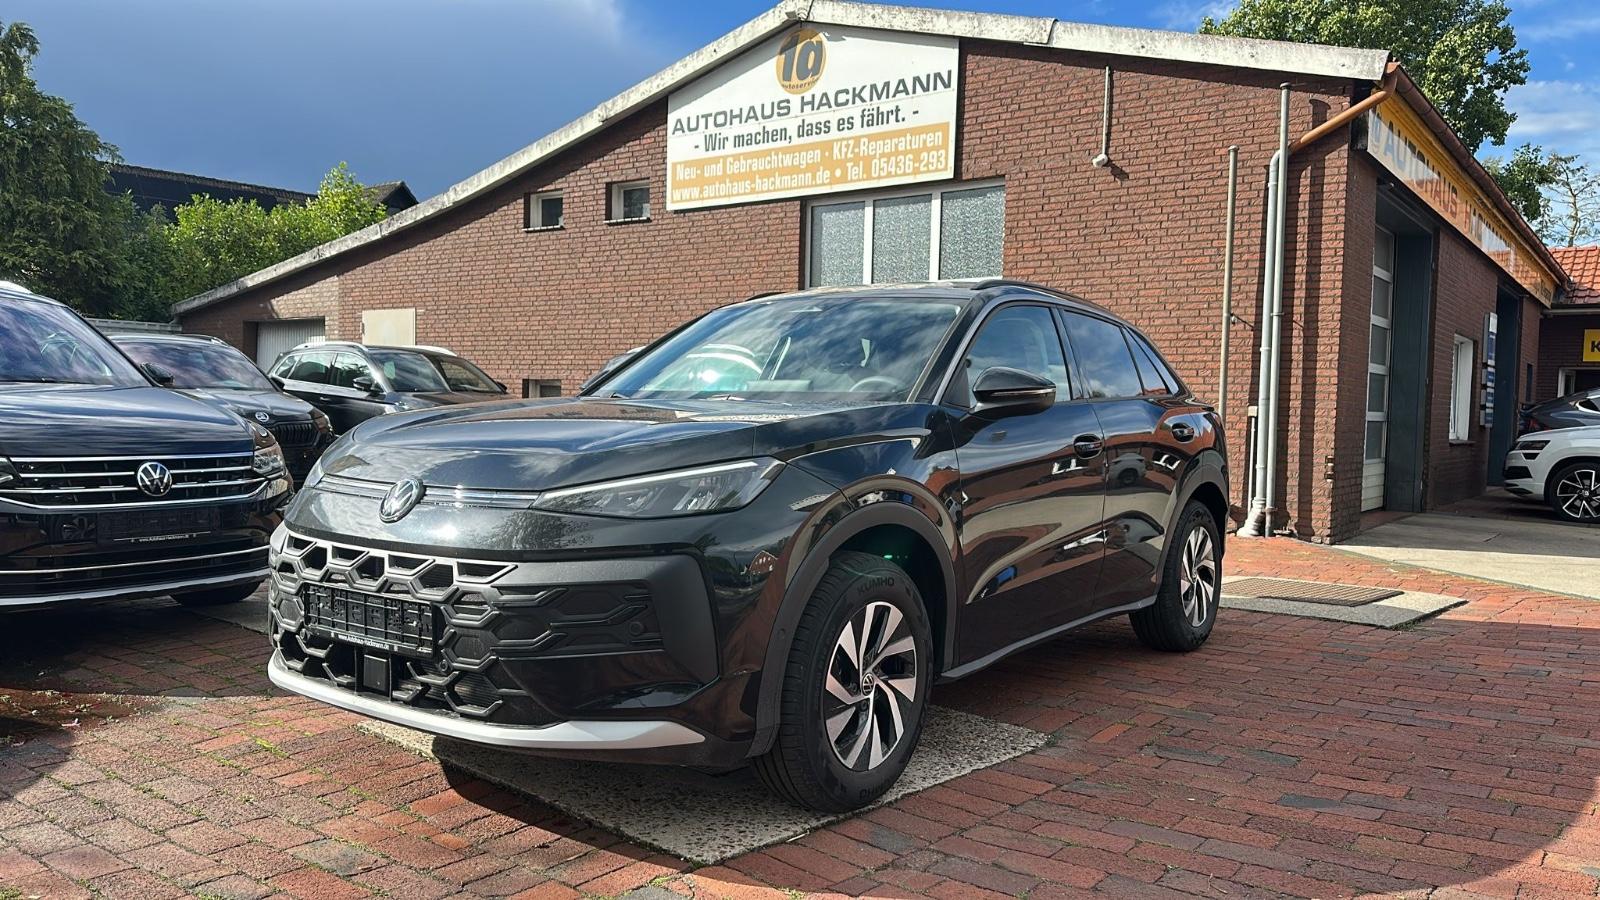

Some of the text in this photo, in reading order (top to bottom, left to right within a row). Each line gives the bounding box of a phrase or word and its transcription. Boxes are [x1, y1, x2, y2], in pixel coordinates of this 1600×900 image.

[671, 69, 953, 136] AUTOHAUS HACKMANN
[704, 132, 729, 152] Wir
[733, 126, 793, 150] machen,
[797, 119, 831, 139] dass
[837, 112, 854, 132] es
[860, 105, 906, 129] fährt.
[672, 149, 946, 202] www.autohaus-hackmann.de Tel. 05436-293
[676, 130, 943, 181] Neu- und Gebrauchtwagen KFZ-Reparaturen
[1384, 121, 1458, 219] AUTOHAUS
[857, 576, 895, 595] KUMHO
